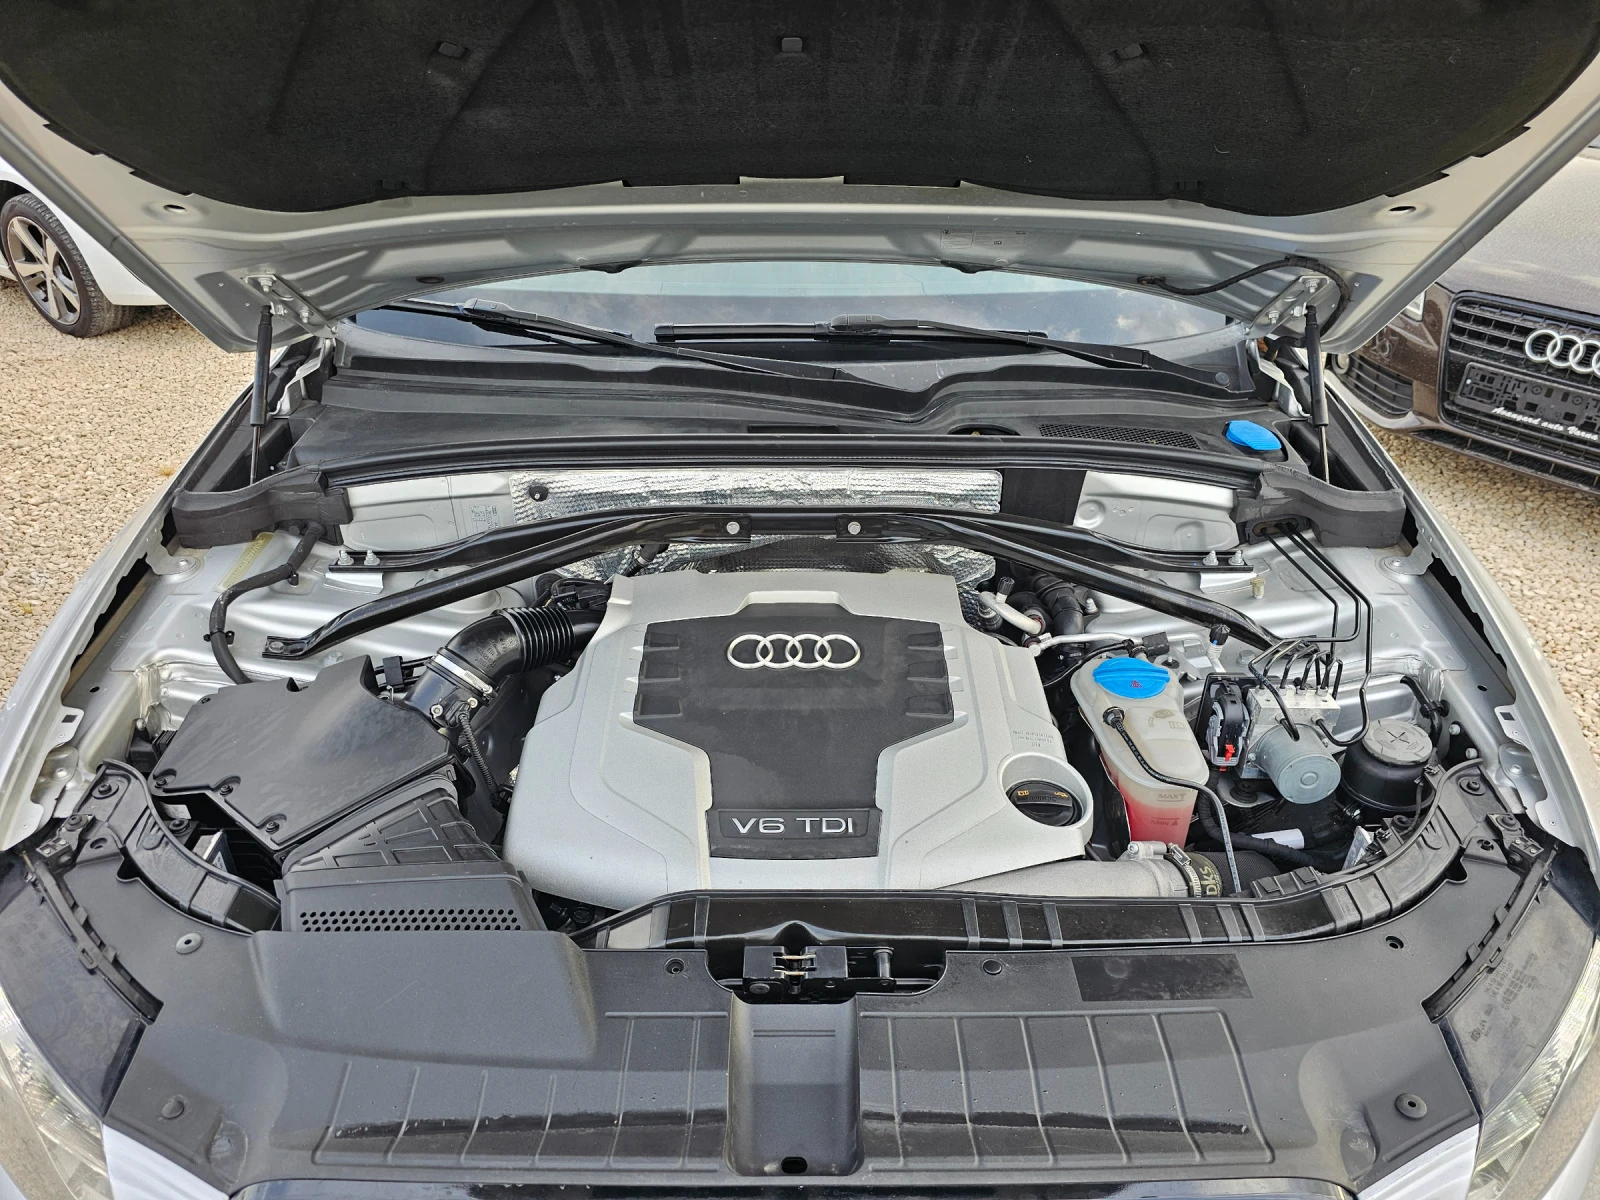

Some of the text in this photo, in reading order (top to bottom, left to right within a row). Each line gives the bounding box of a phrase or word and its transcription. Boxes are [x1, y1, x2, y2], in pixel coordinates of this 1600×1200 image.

[1541, 421, 1564, 431] auto
[1567, 425, 1599, 440] Varna
[731, 817, 853, 834] V6 TDI
